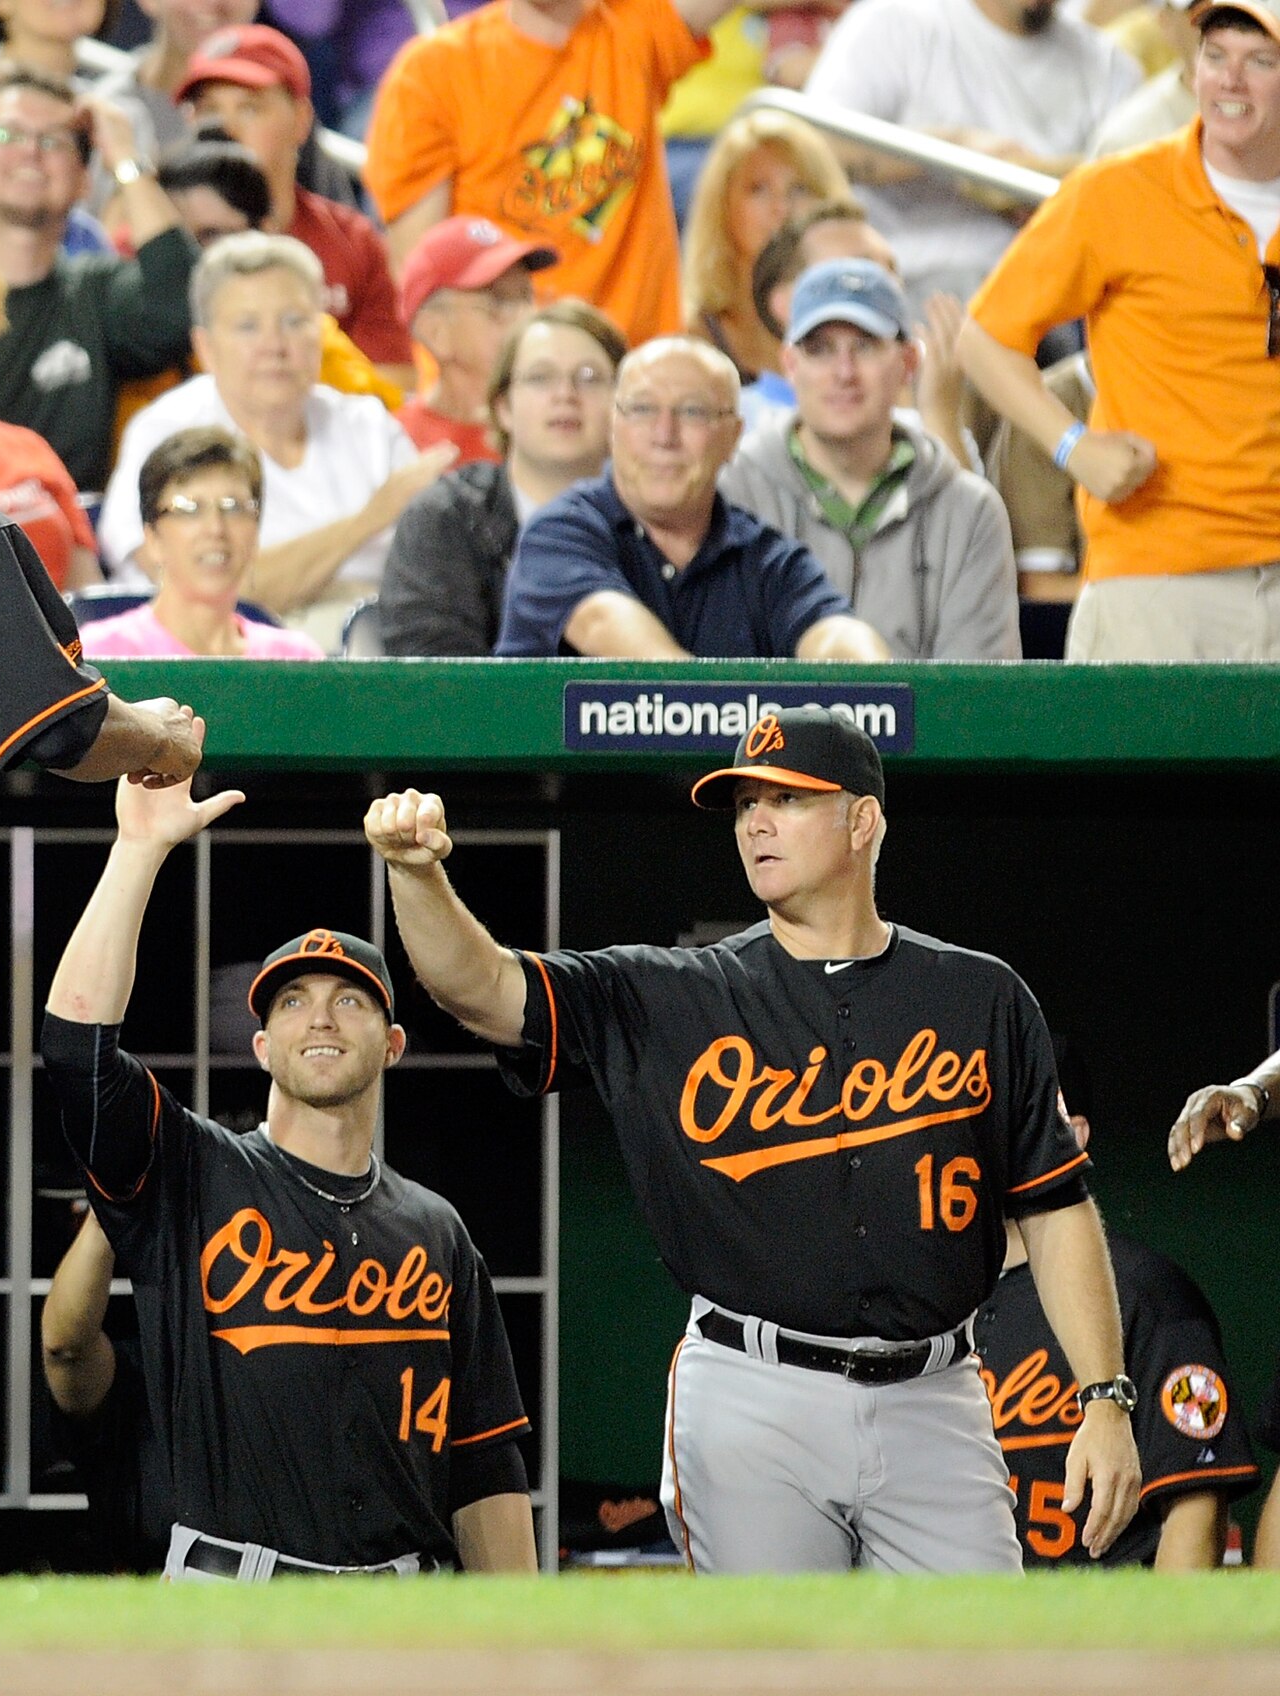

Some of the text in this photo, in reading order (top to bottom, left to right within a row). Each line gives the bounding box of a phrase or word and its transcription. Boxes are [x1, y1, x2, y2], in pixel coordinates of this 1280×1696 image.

[745, 714, 785, 758] O's
[680, 1028, 992, 1143] Orioles
[914, 1153, 981, 1232] 16
[200, 1206, 453, 1323] Oriole
[399, 1367, 451, 1452] 14
[1008, 1475, 1077, 1559] 5
